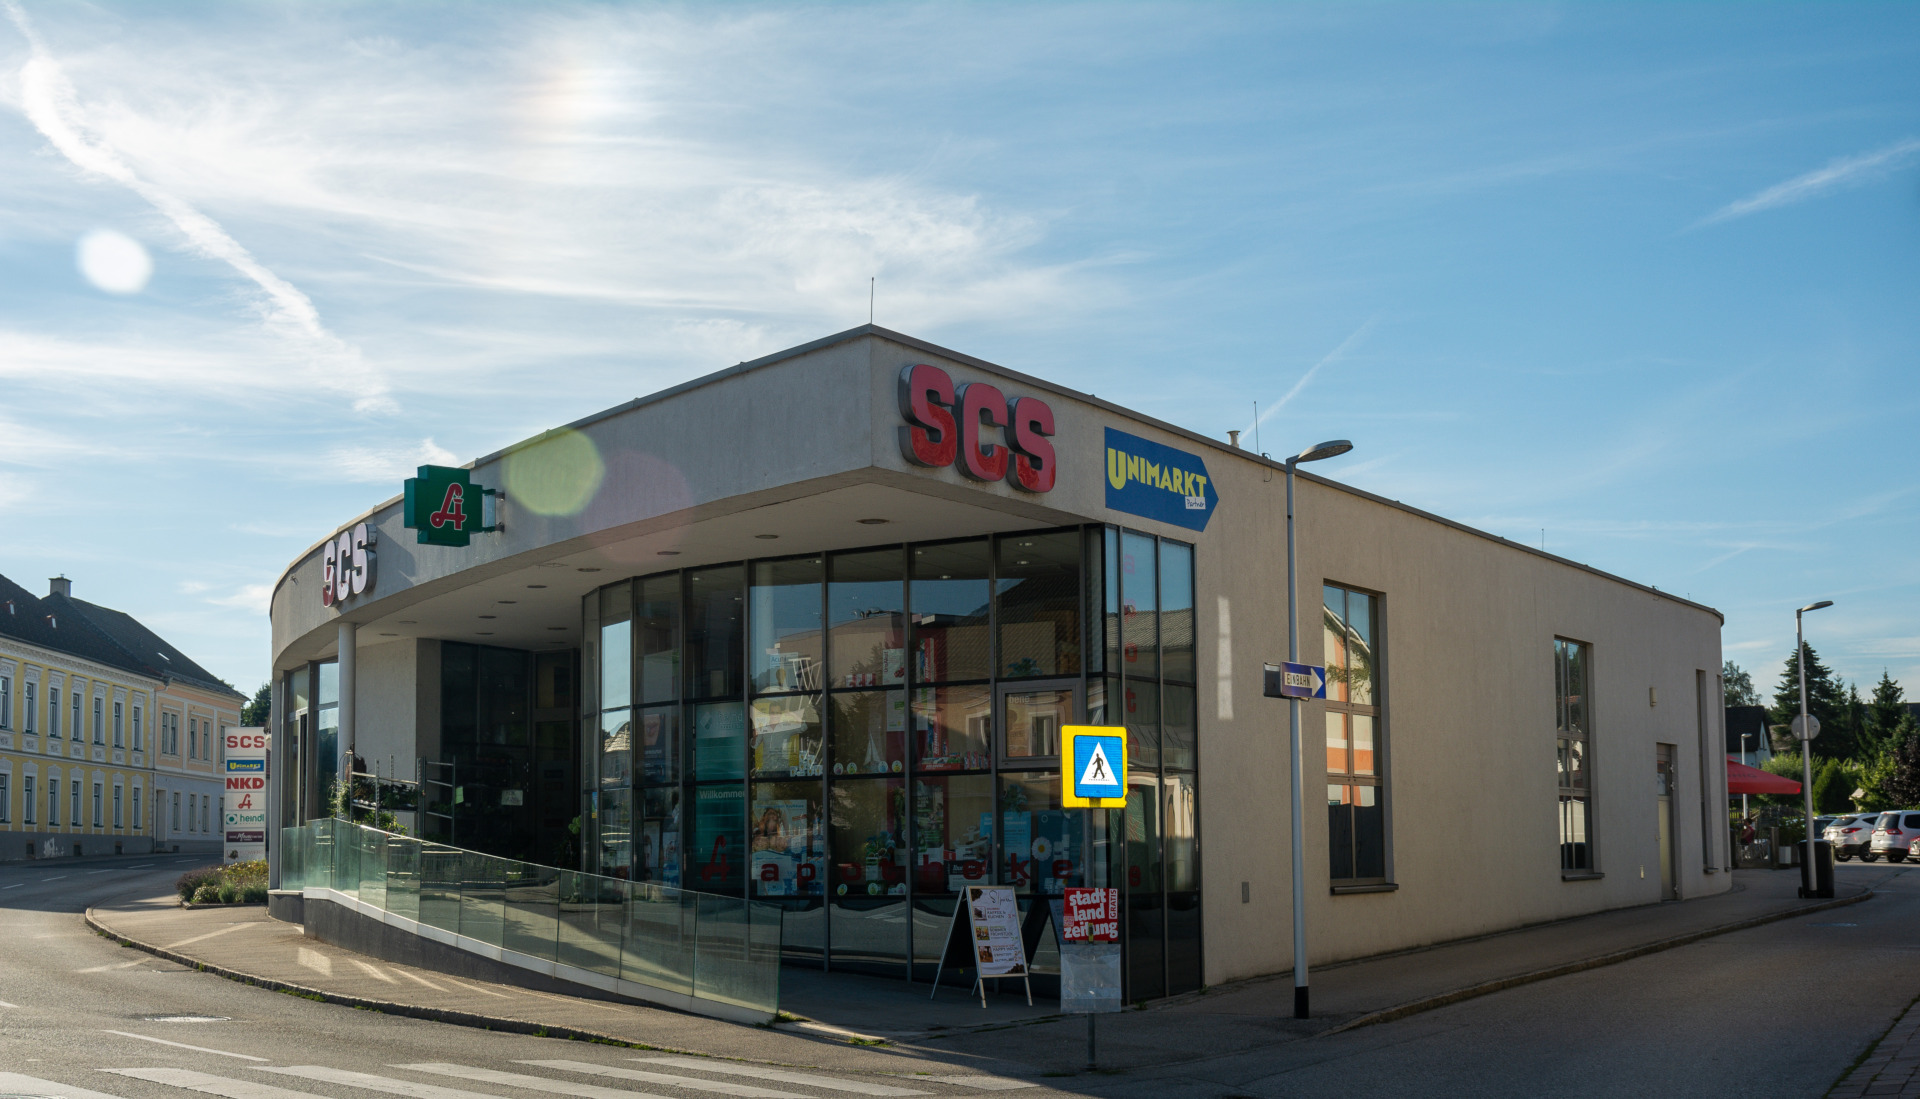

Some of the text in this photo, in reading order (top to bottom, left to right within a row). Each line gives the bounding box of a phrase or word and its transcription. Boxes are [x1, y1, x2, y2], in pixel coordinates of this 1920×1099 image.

[900, 364, 1057, 493] SCS
[1107, 447, 1207, 498] UNIMARKT
[1186, 498, 1205, 508] Partner
[323, 522, 372, 608] SCS
[1286, 673, 1311, 687] EINBAHN
[227, 736, 264, 748] SCS
[226, 778, 265, 789] NKD
[240, 813, 264, 823] heindl
[1069, 887, 1107, 906] stadt
[1109, 889, 1117, 918] GRATIS
[1072, 903, 1106, 922] land
